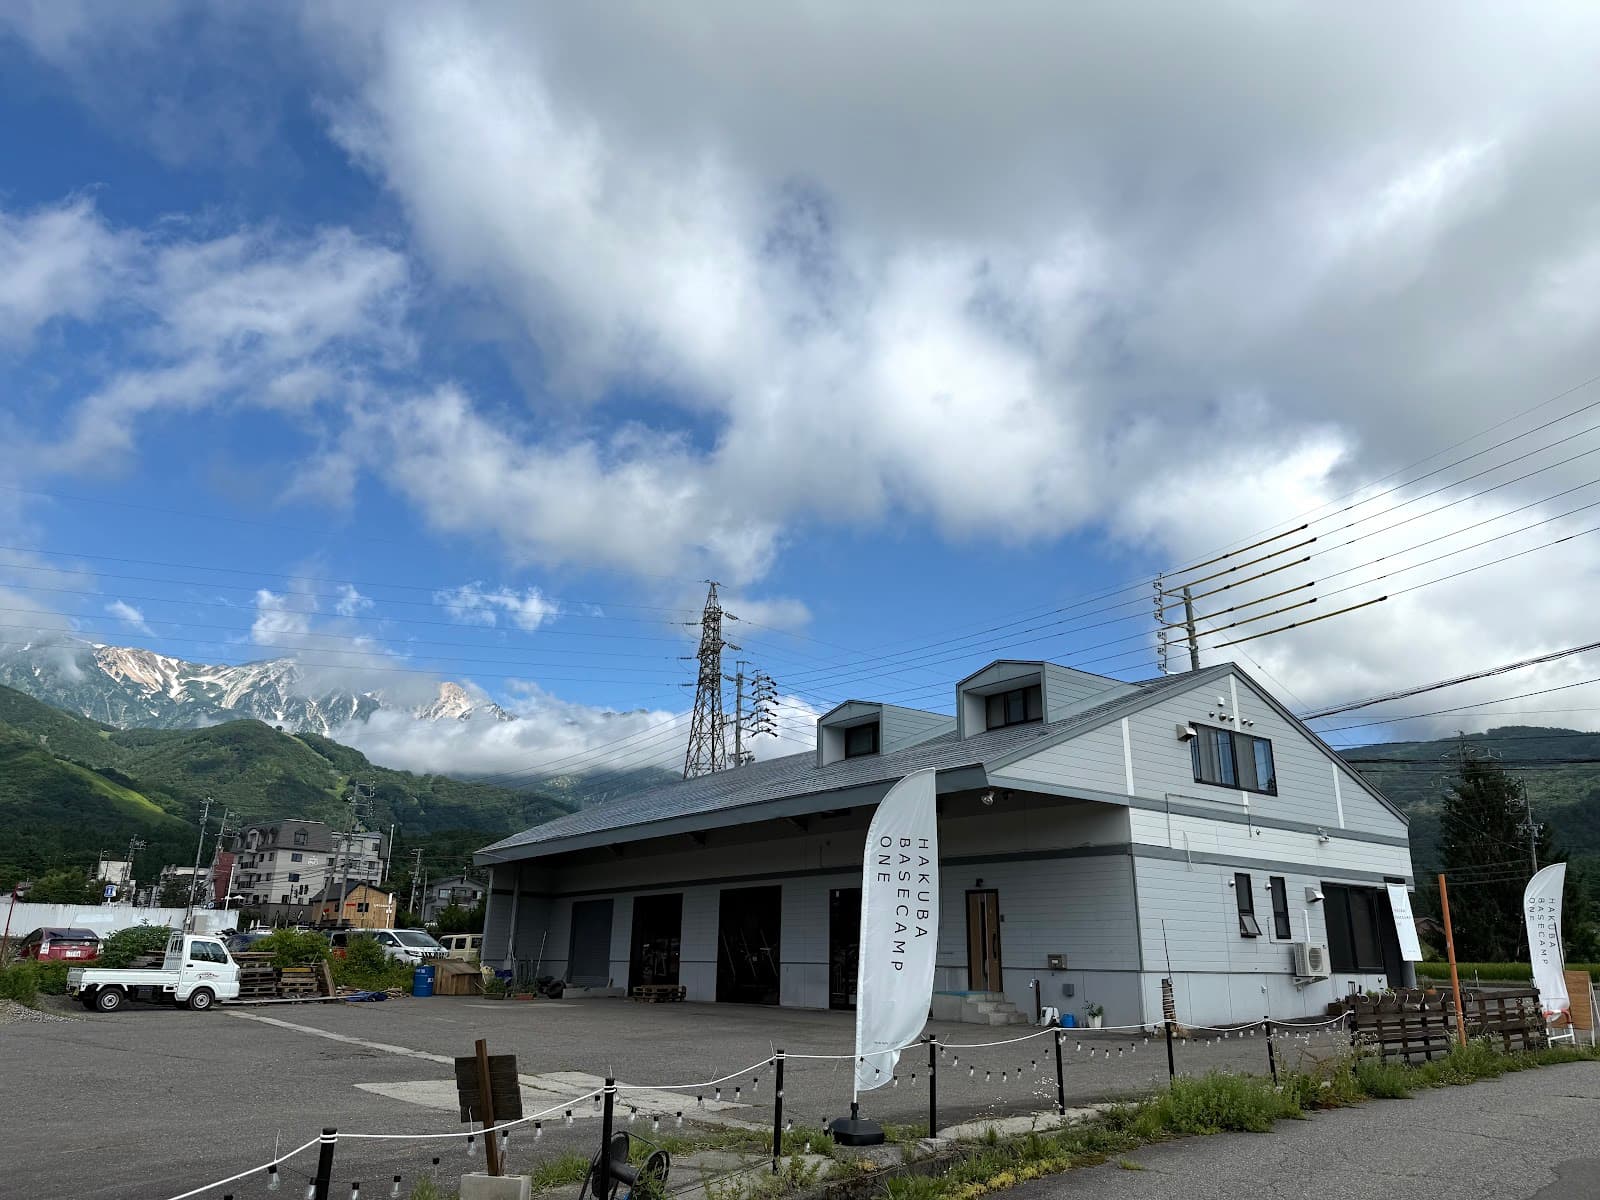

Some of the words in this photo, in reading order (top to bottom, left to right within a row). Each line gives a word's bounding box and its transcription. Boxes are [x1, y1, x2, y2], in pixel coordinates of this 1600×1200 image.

[877, 836, 893, 883] ONE
[914, 838, 930, 938] HAKUBA
[890, 838, 911, 971] BASECAMP
[1537, 898, 1549, 965] BASECAMP
[1547, 898, 1556, 948] HAKUBA
